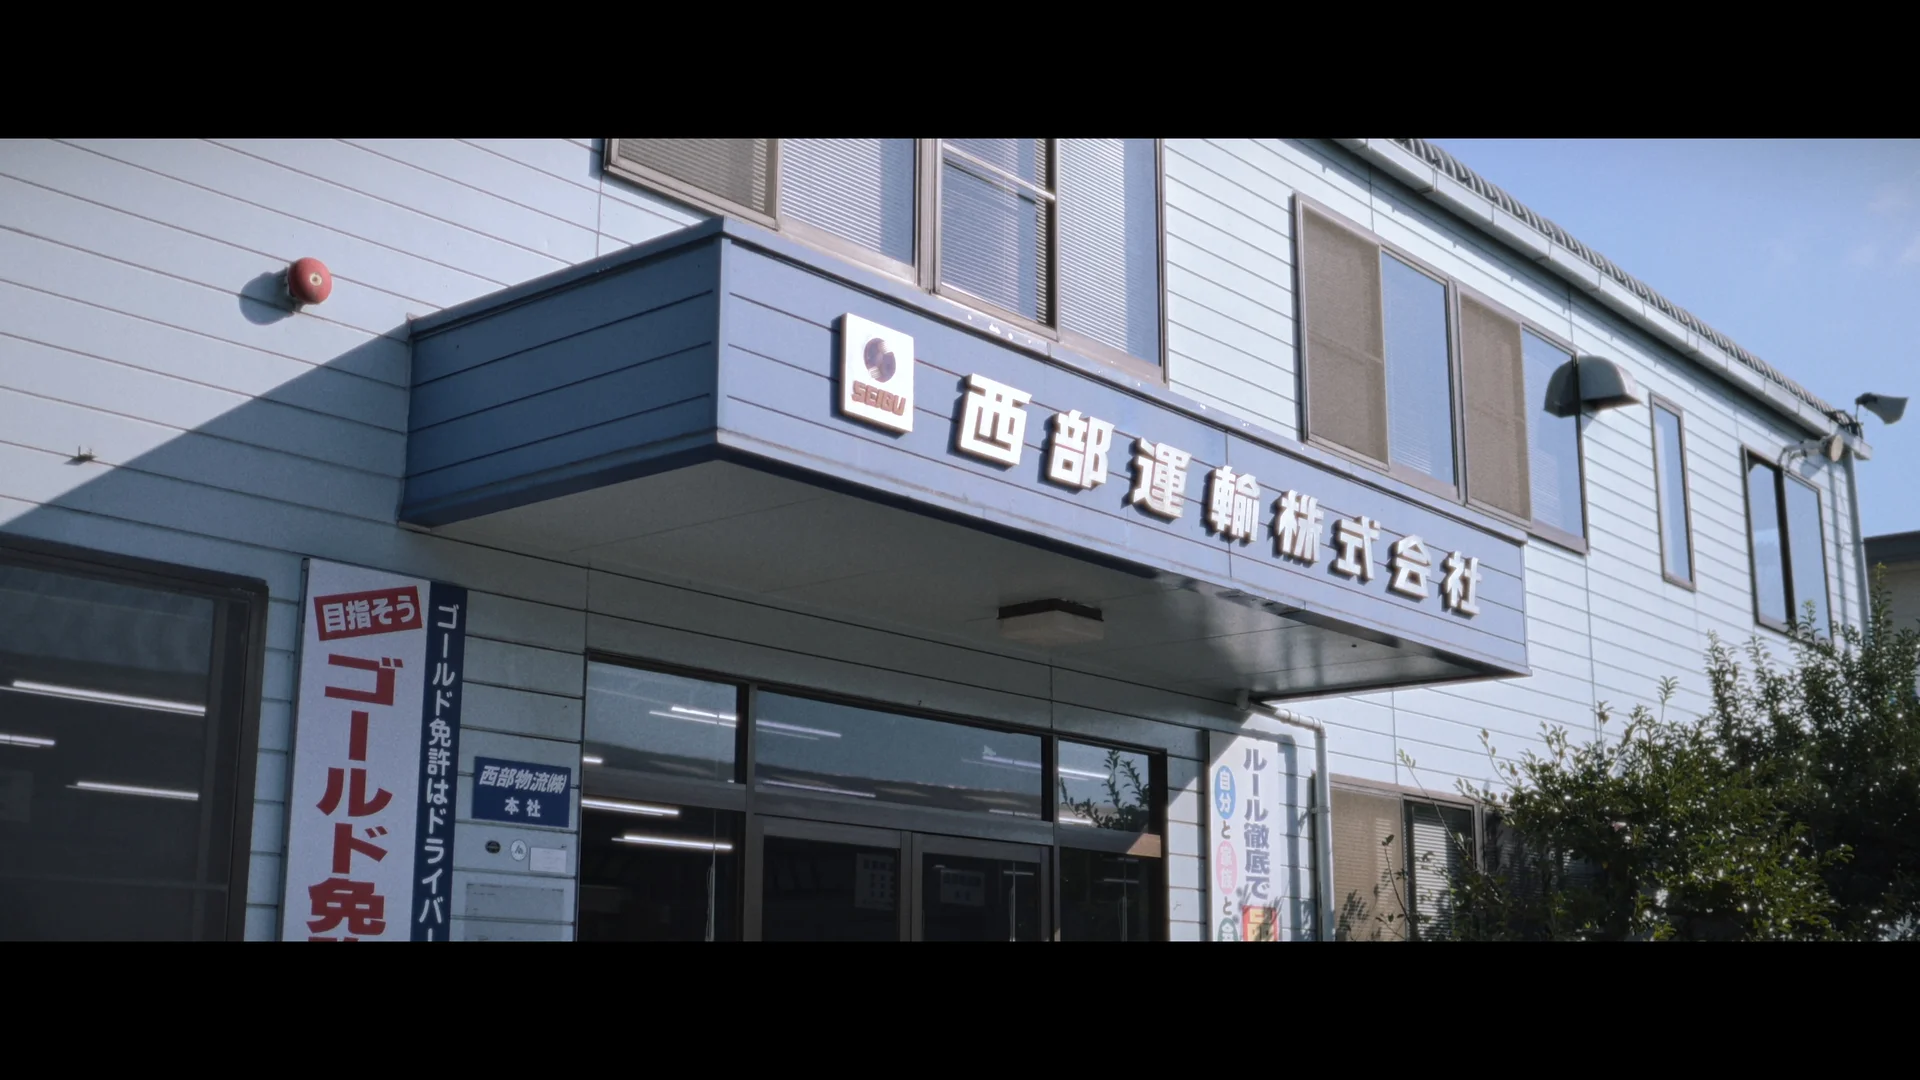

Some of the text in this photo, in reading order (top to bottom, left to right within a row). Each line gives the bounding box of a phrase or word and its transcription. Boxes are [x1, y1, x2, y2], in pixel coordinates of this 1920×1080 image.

[851, 380, 906, 416] SEIBU
[956, 372, 1482, 616] 西部運輸株式会社
[322, 595, 416, 633] 目指そう
[306, 653, 403, 941] ゴールド免
[504, 797, 541, 817] 本社
[1243, 748, 1271, 900] ルール徹底で
